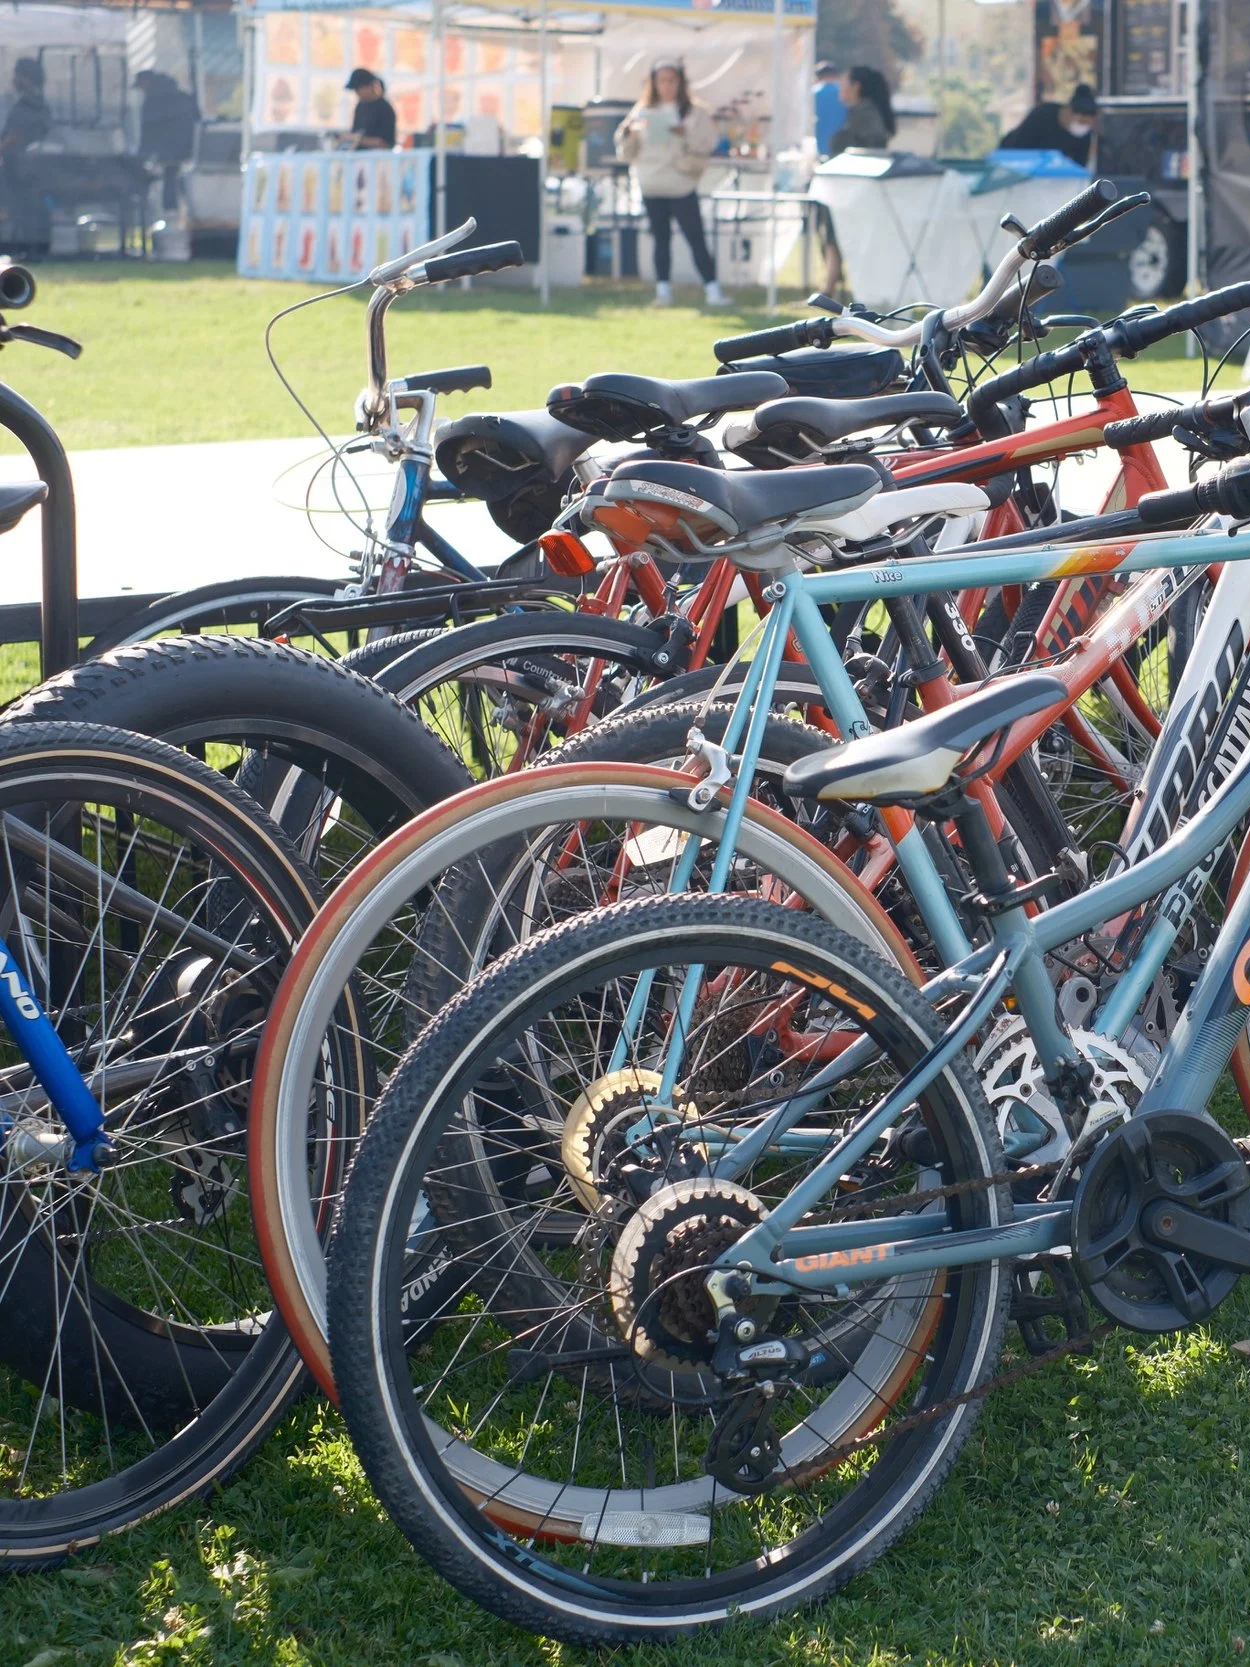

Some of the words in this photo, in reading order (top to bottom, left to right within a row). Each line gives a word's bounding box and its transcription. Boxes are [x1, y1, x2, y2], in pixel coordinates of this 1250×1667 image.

[870, 569, 903, 583] Nice
[944, 602, 976, 651] 330
[795, 1244, 888, 1273] GIANT
[748, 1345, 783, 1361] ALTUS
